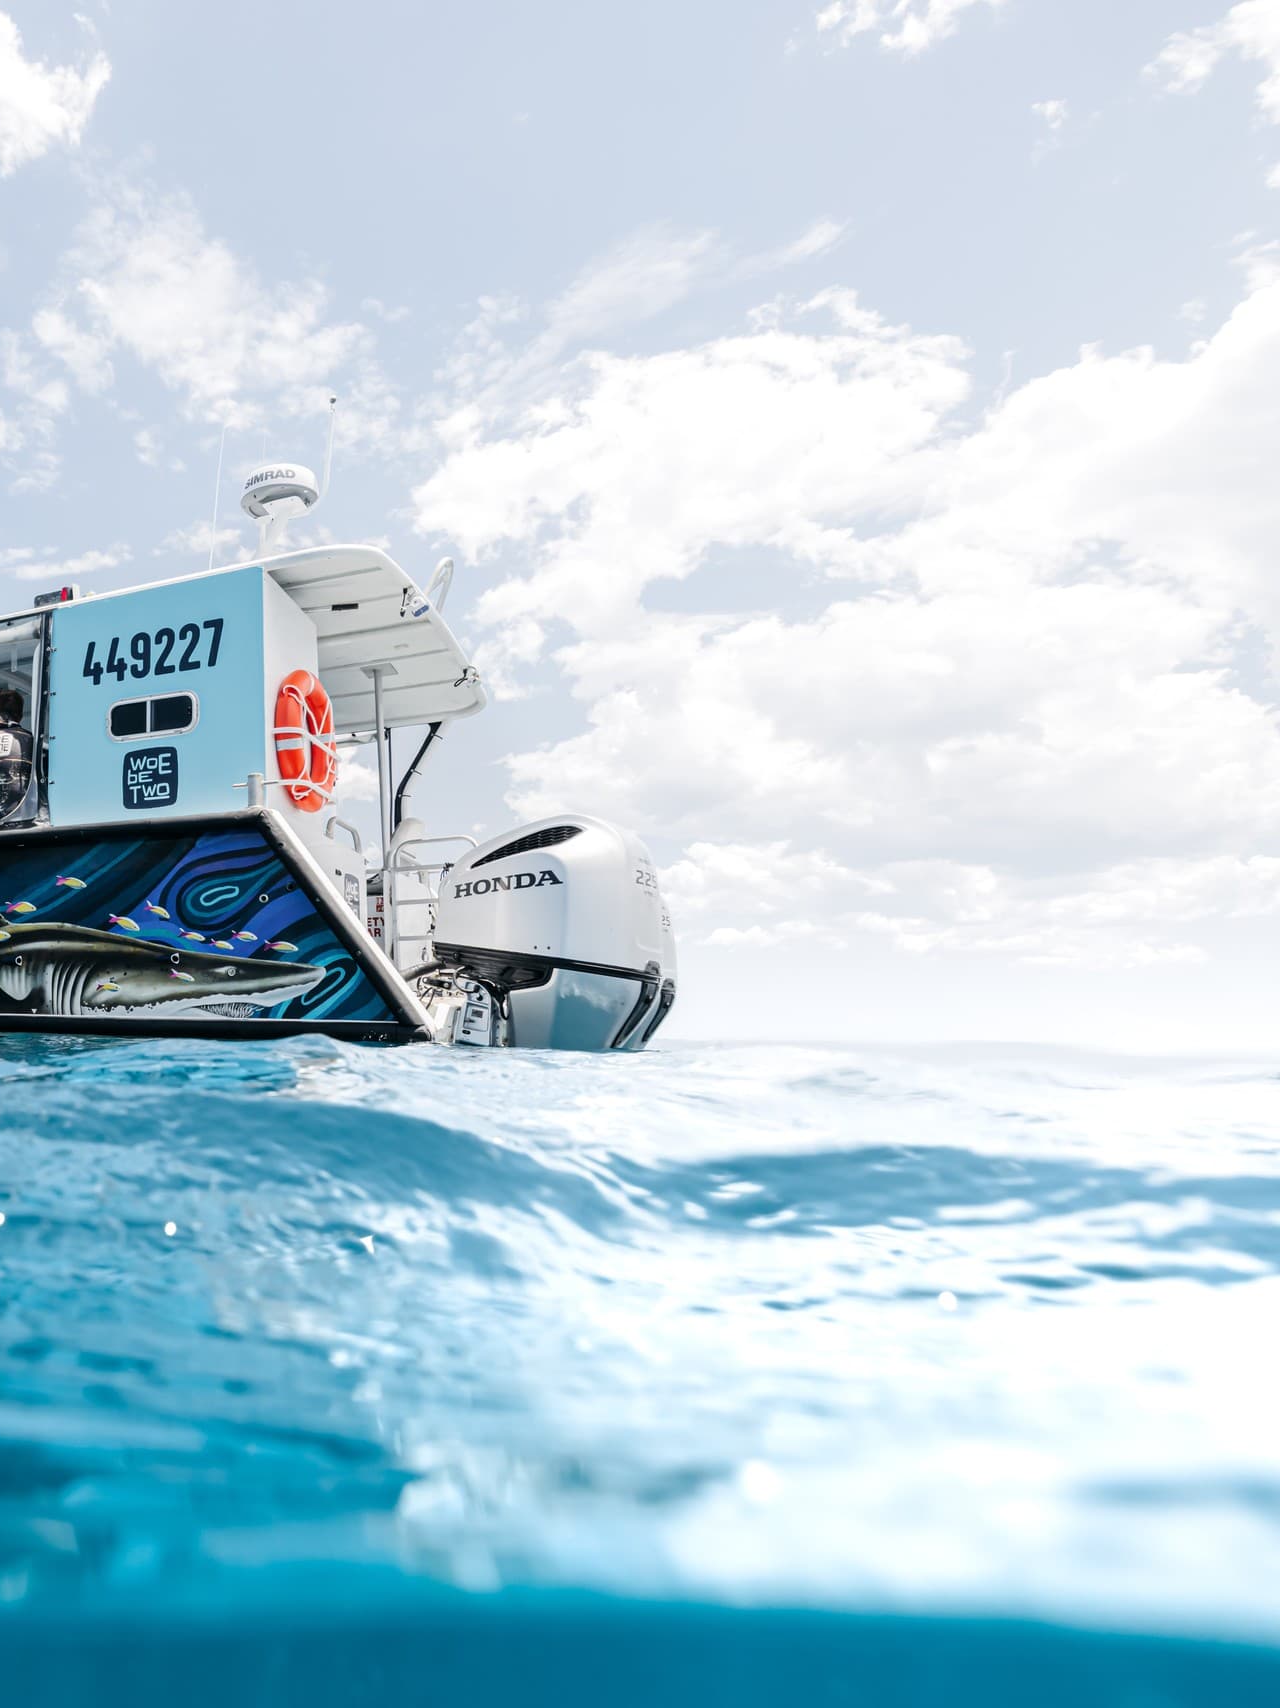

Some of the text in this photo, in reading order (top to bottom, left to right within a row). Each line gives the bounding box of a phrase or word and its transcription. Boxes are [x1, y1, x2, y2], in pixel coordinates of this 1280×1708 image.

[244, 469, 296, 490] SIMRAD
[83, 618, 224, 685] 449227
[454, 870, 564, 899] HONDA
